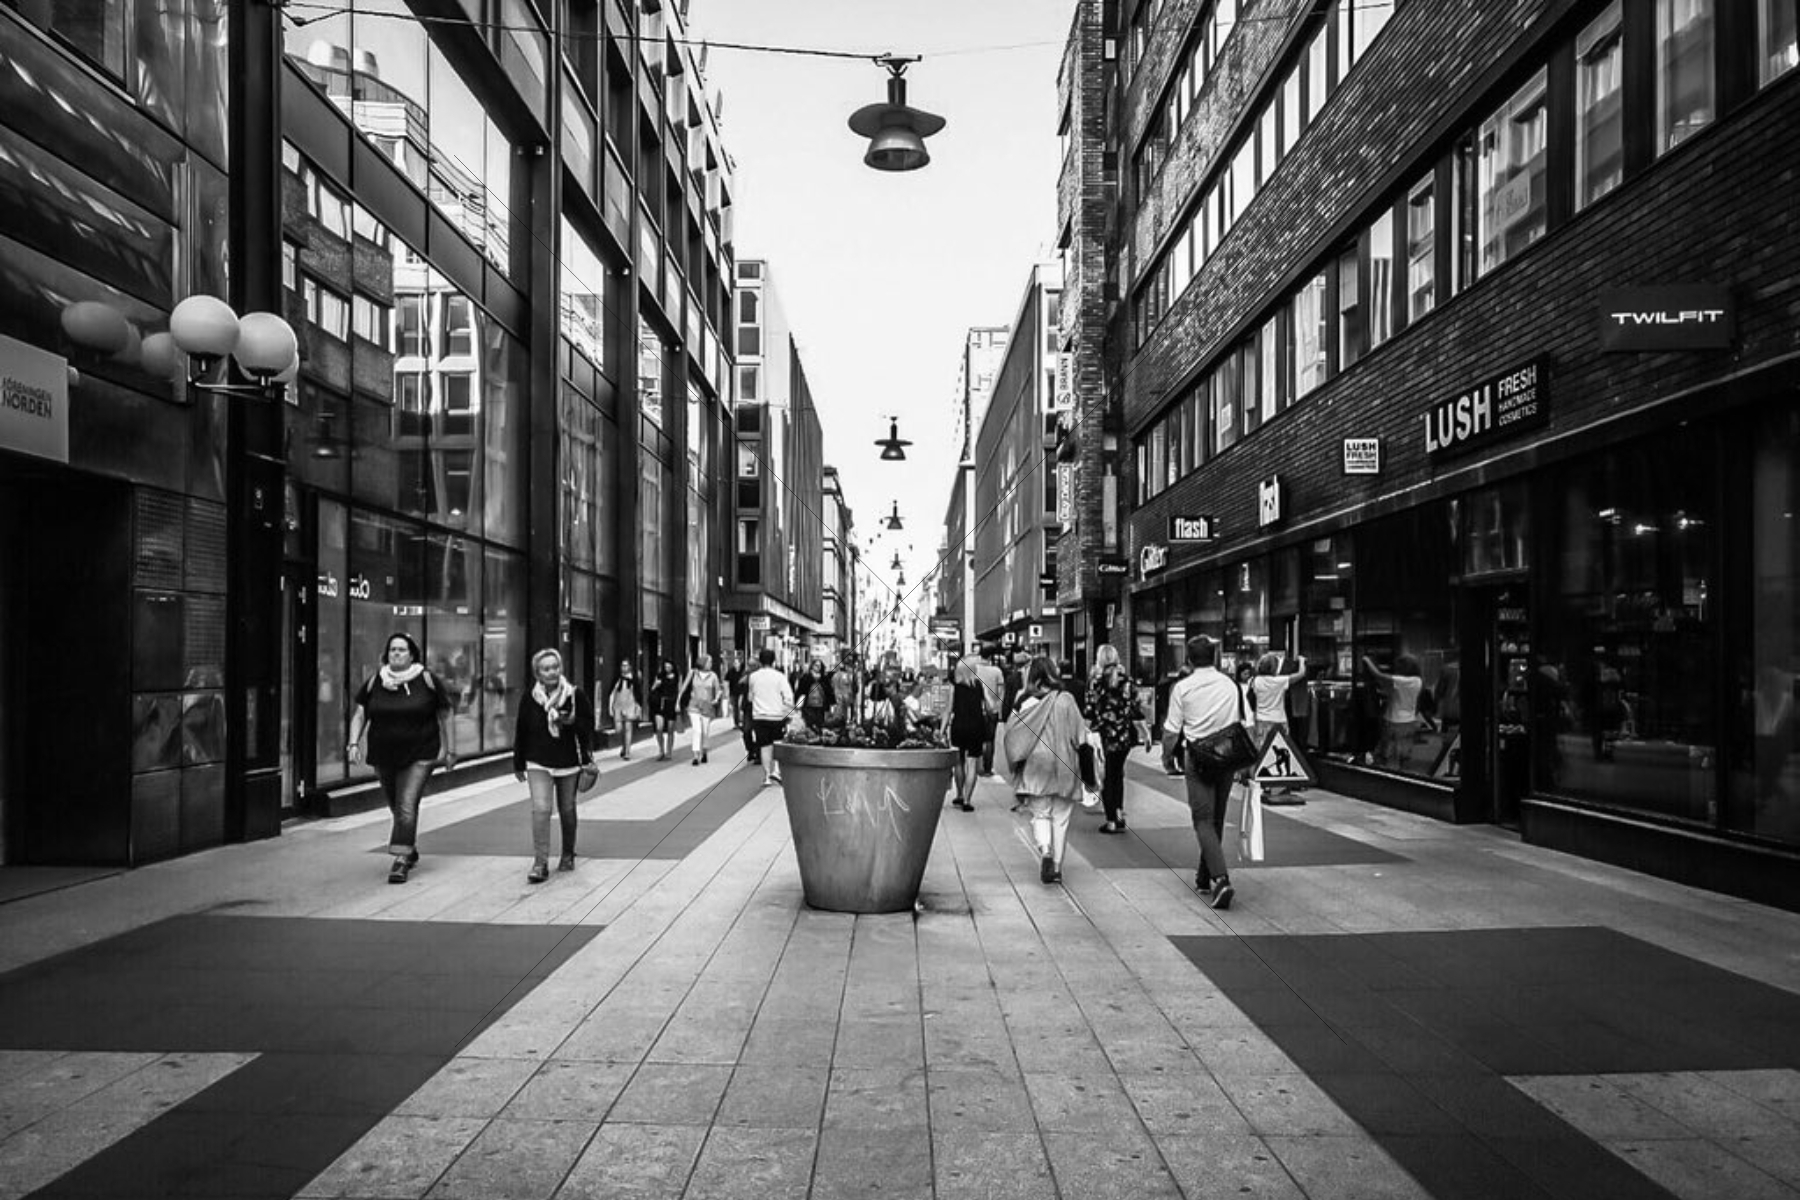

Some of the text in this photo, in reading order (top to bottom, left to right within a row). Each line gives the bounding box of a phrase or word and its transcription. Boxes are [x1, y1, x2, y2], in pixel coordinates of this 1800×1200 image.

[1611, 310, 1725, 325] TWILFIT
[1498, 364, 1538, 400] FRESH
[2, 389, 52, 418] NORDEN
[1424, 384, 1492, 454] LUSH
[1346, 442, 1377, 451] LUSH
[1175, 517, 1209, 539] flash
